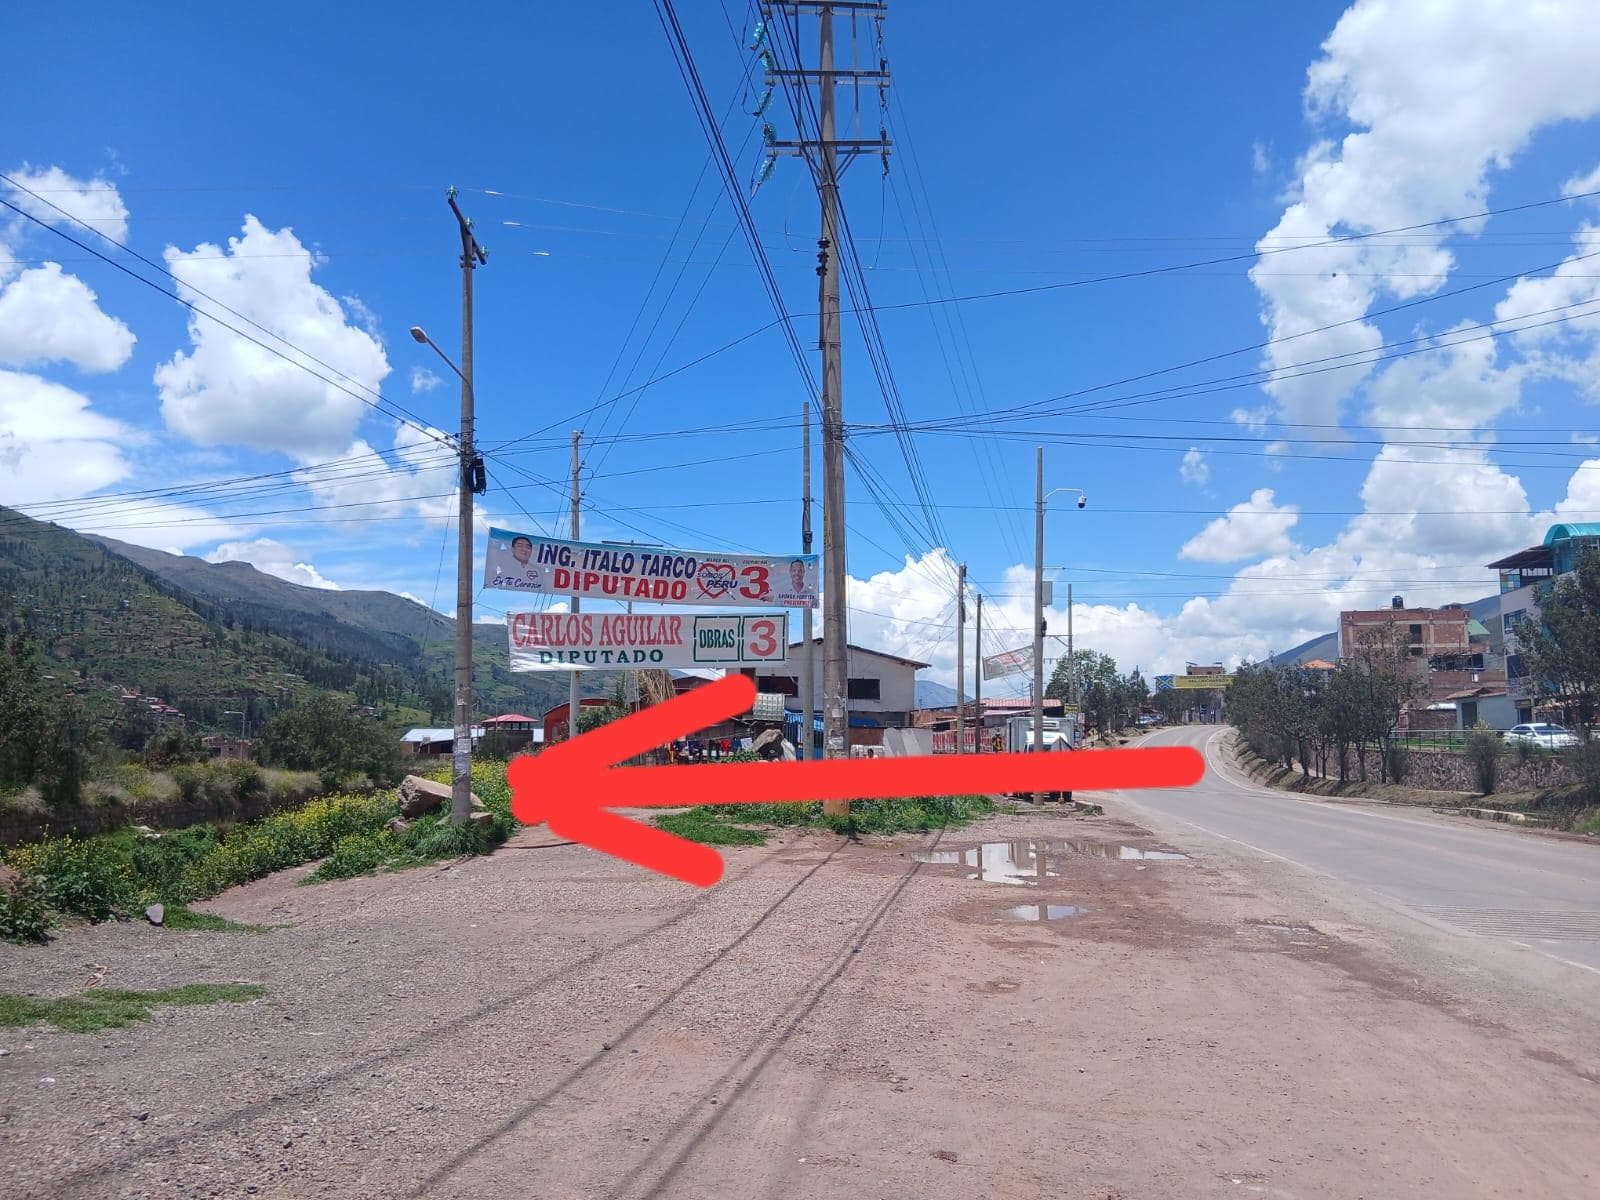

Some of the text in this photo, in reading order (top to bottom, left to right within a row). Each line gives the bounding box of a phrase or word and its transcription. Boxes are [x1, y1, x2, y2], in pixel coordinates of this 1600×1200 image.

[537, 543, 697, 579] ING. ITALO TARCO
[554, 568, 687, 600] DIPUTADO
[740, 566, 770, 599] 3
[512, 613, 683, 647] CARLOS AGUILAR
[699, 628, 736, 649] OBRAS
[750, 619, 777, 657] 3
[539, 649, 664, 664] DIPUTADO
